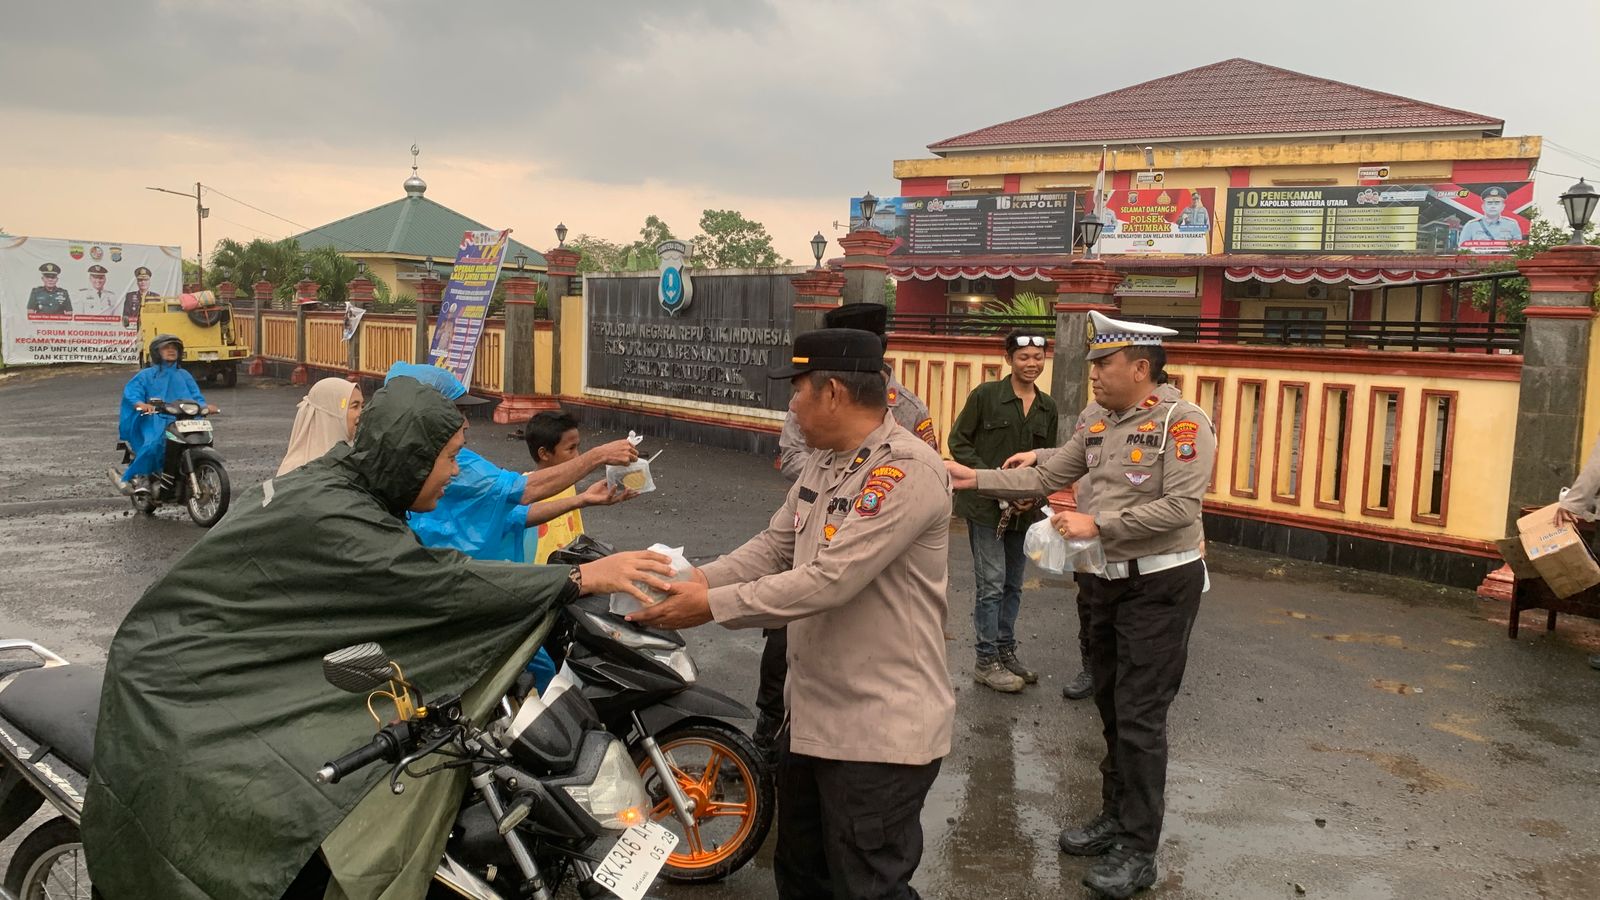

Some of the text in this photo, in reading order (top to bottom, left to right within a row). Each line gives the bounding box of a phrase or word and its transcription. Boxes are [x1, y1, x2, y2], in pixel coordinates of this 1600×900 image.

[996, 196, 1011, 210] 16
[1236, 191, 1259, 207] 10
[1260, 191, 1322, 200] PENEKANAN
[1012, 200, 1067, 209] KAPOLRI
[1130, 215, 1164, 223] POLSEK
[1122, 223, 1170, 233] PATUMBAK
[640, 324, 676, 339] NEGARA
[679, 326, 728, 343] REPUBLIK
[729, 327, 792, 346] INDONESIA
[719, 347, 770, 366] MEDAN
[649, 831, 675, 861] 05 29
[596, 864, 623, 888] BK
